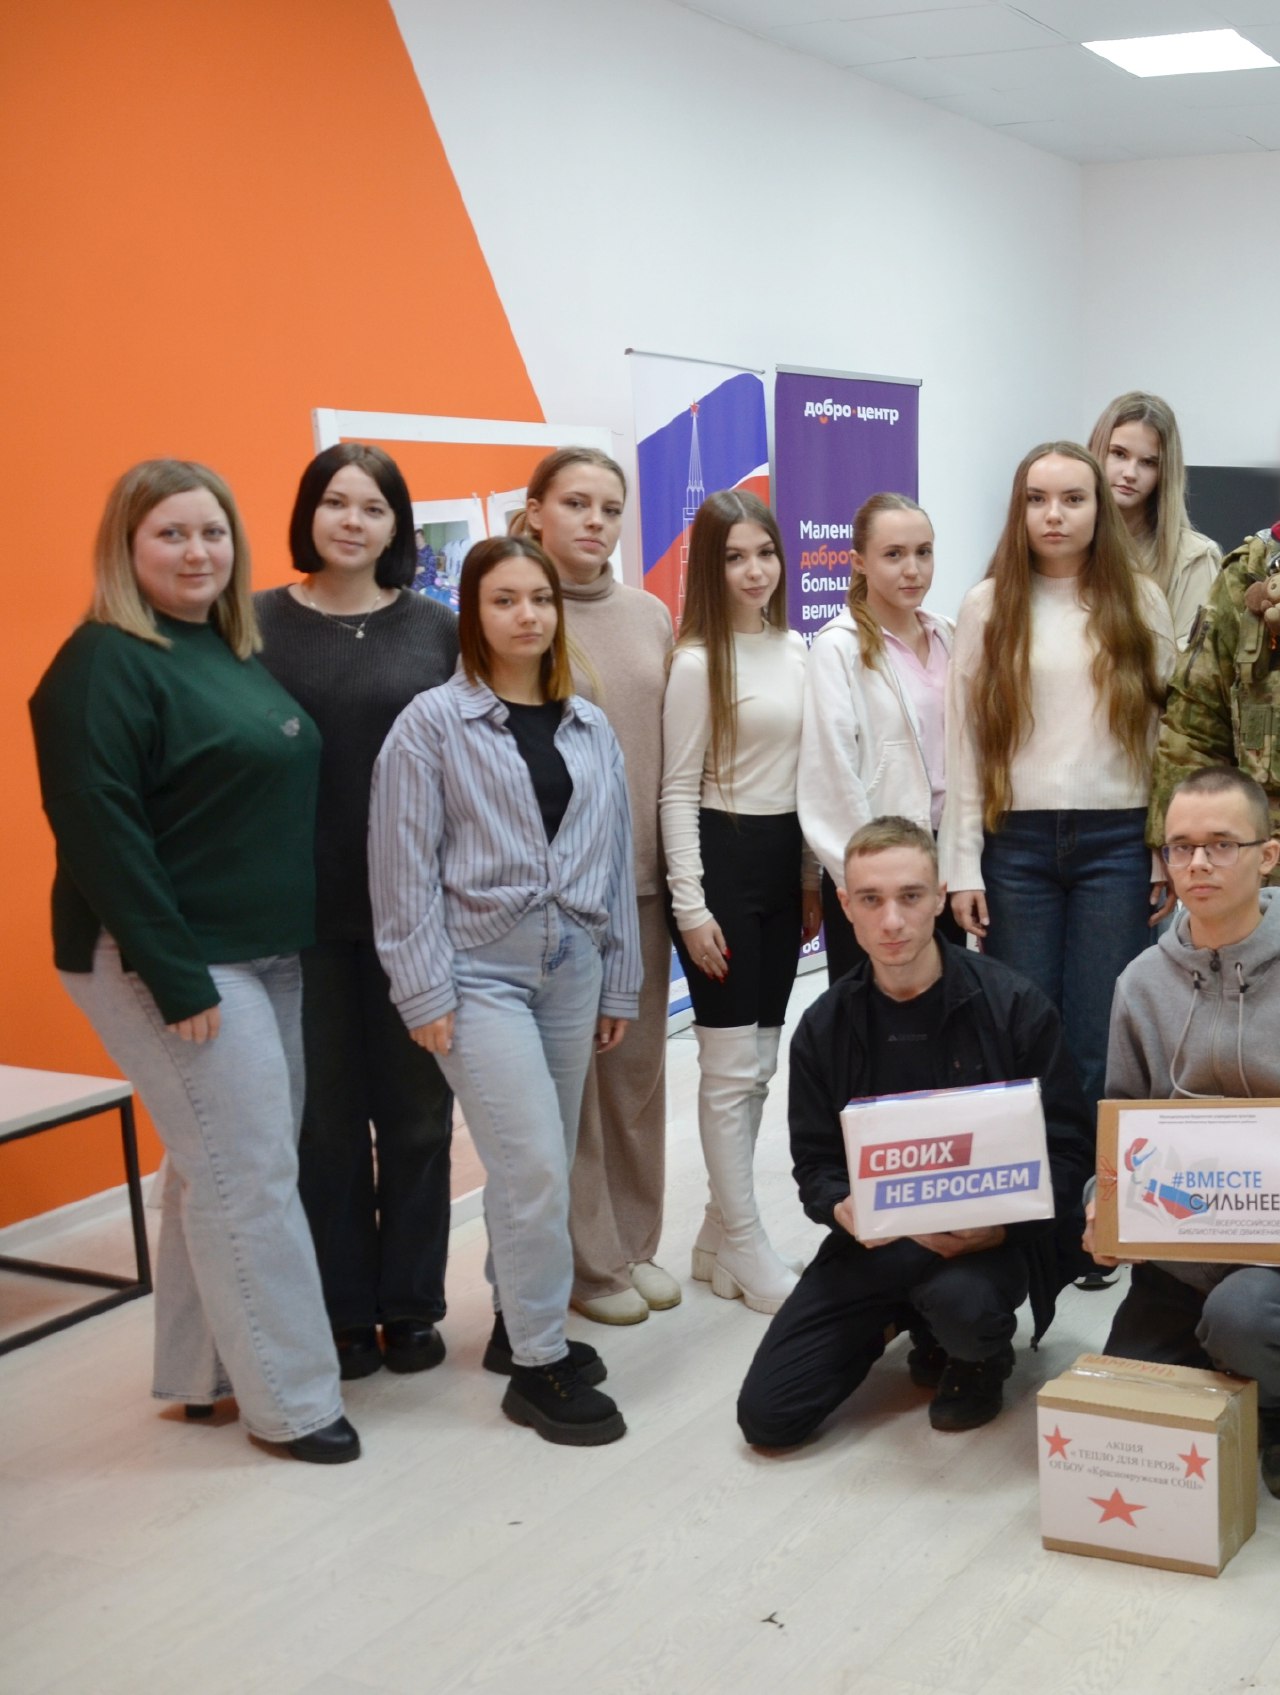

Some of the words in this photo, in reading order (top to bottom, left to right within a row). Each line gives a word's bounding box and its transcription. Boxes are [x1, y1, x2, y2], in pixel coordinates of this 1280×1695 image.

[800, 544, 850, 571] добро
[869, 1140, 954, 1171] СВОИХ
[885, 1182, 916, 1204] НЕ
[921, 1167, 1029, 1201] БРОСАЕМ
[1172, 1171, 1262, 1189] #ВМЕСТЕ
[1189, 1193, 1280, 1211] СИЛЬНЕЕ
[1105, 1441, 1144, 1454] АКЦИЯ
[1116, 1455, 1139, 1466] ДЛЯ
